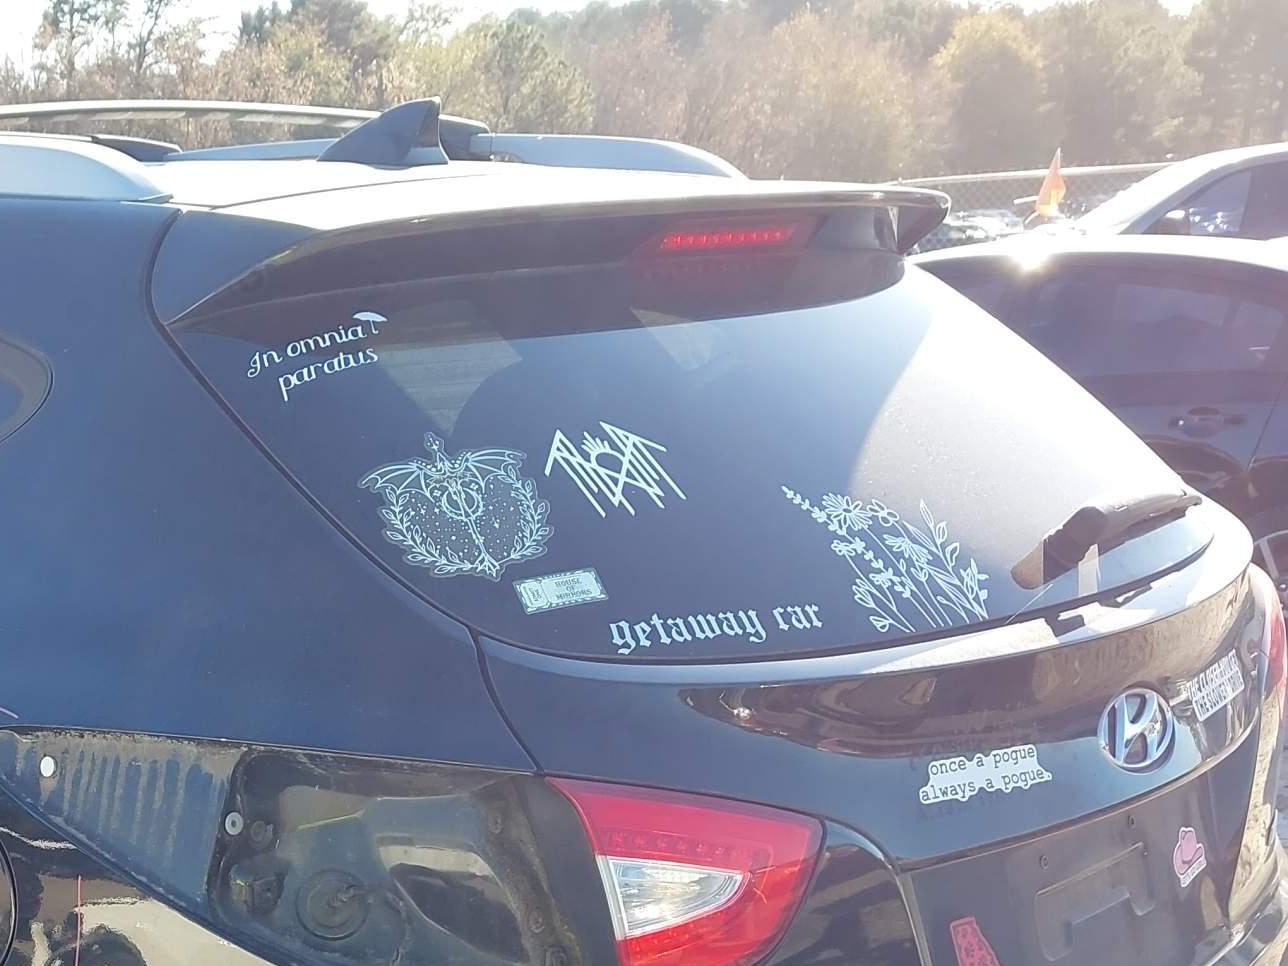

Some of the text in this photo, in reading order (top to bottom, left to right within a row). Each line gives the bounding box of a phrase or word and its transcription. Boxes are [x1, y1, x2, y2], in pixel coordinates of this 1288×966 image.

[247, 325, 368, 378] In omnia
[278, 348, 378, 402] paratus
[609, 603, 824, 655] getaway car
[930, 746, 1035, 775] once a pogue
[921, 780, 976, 801] always
[985, 778, 994, 789] a
